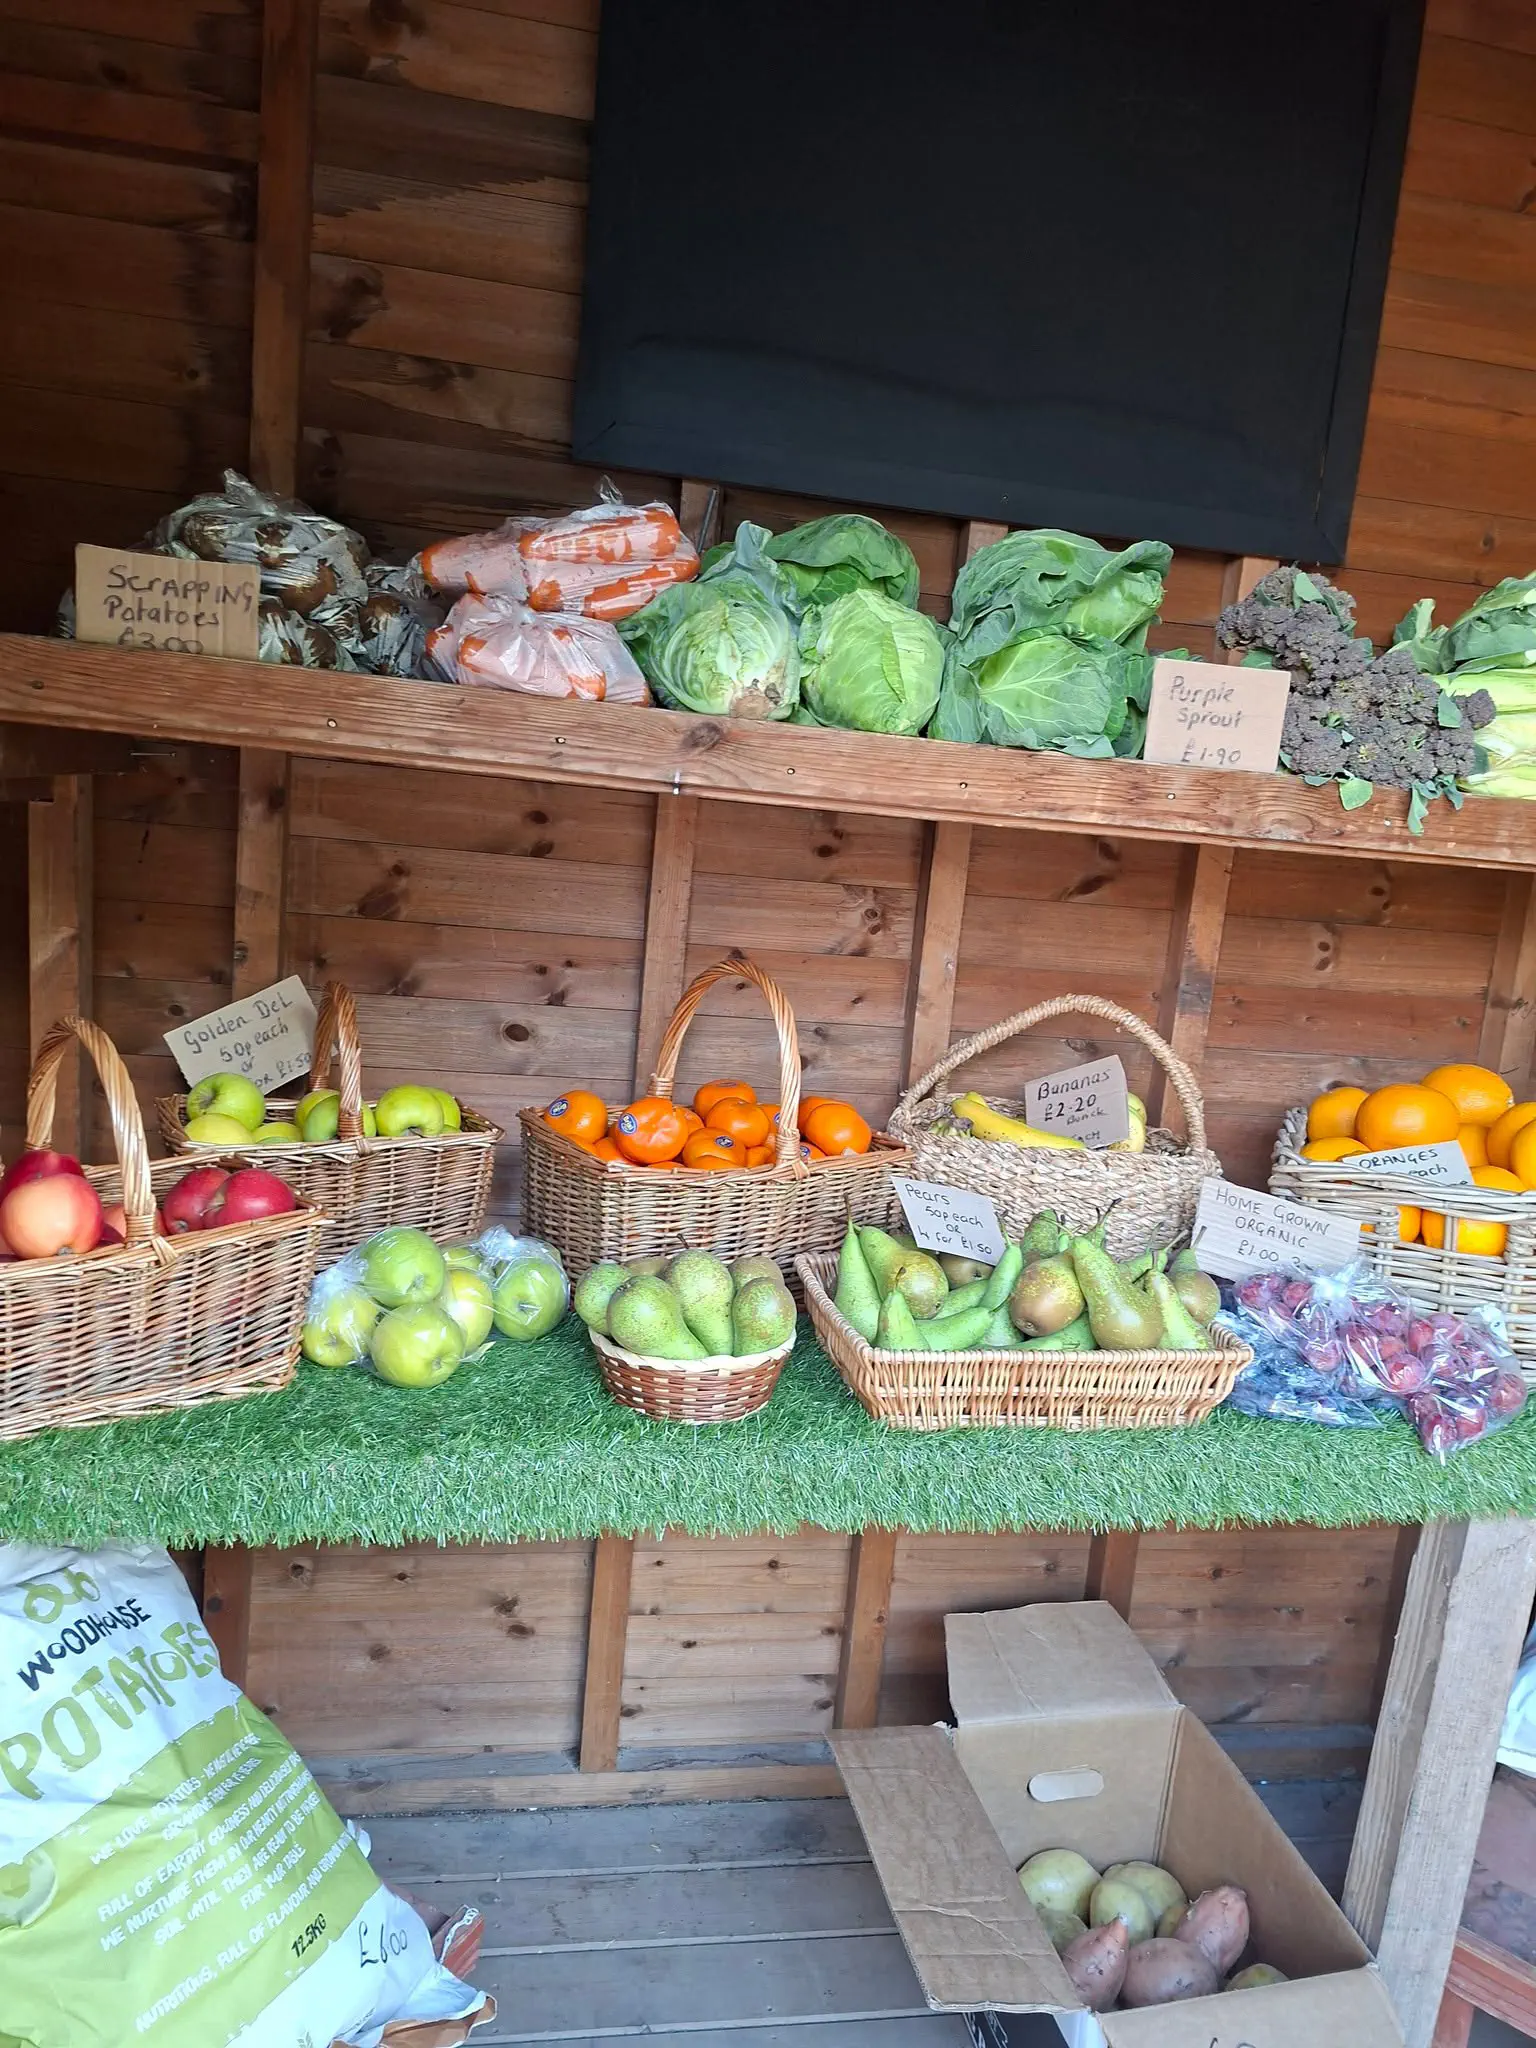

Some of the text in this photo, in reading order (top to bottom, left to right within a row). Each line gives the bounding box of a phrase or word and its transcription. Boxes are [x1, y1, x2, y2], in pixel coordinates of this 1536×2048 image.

[183, 1014, 248, 1055] Golden
[1037, 1069, 1112, 1101] Bananas
[1044, 1094, 1097, 1122] £2.20
[1359, 1149, 1438, 1169] ORANGES
[904, 1183, 951, 1205] Pears
[1216, 1187, 1330, 1236] HOME GROWN
[1235, 1216, 1309, 1248] ORGANIC
[16, 1598, 152, 1692] WOODHOUSE
[0, 1621, 220, 1801] POTATOES
[97, 1892, 135, 1922] FULL
[134, 1875, 154, 1897] OF
[156, 1840, 206, 1884] EARTHY
[100, 1926, 126, 1952] WE
[153, 1917, 187, 1947] SOIL
[216, 1941, 249, 1970] FULL
[248, 1922, 266, 1944] OF
[266, 1882, 312, 1930] FLAVOUR
